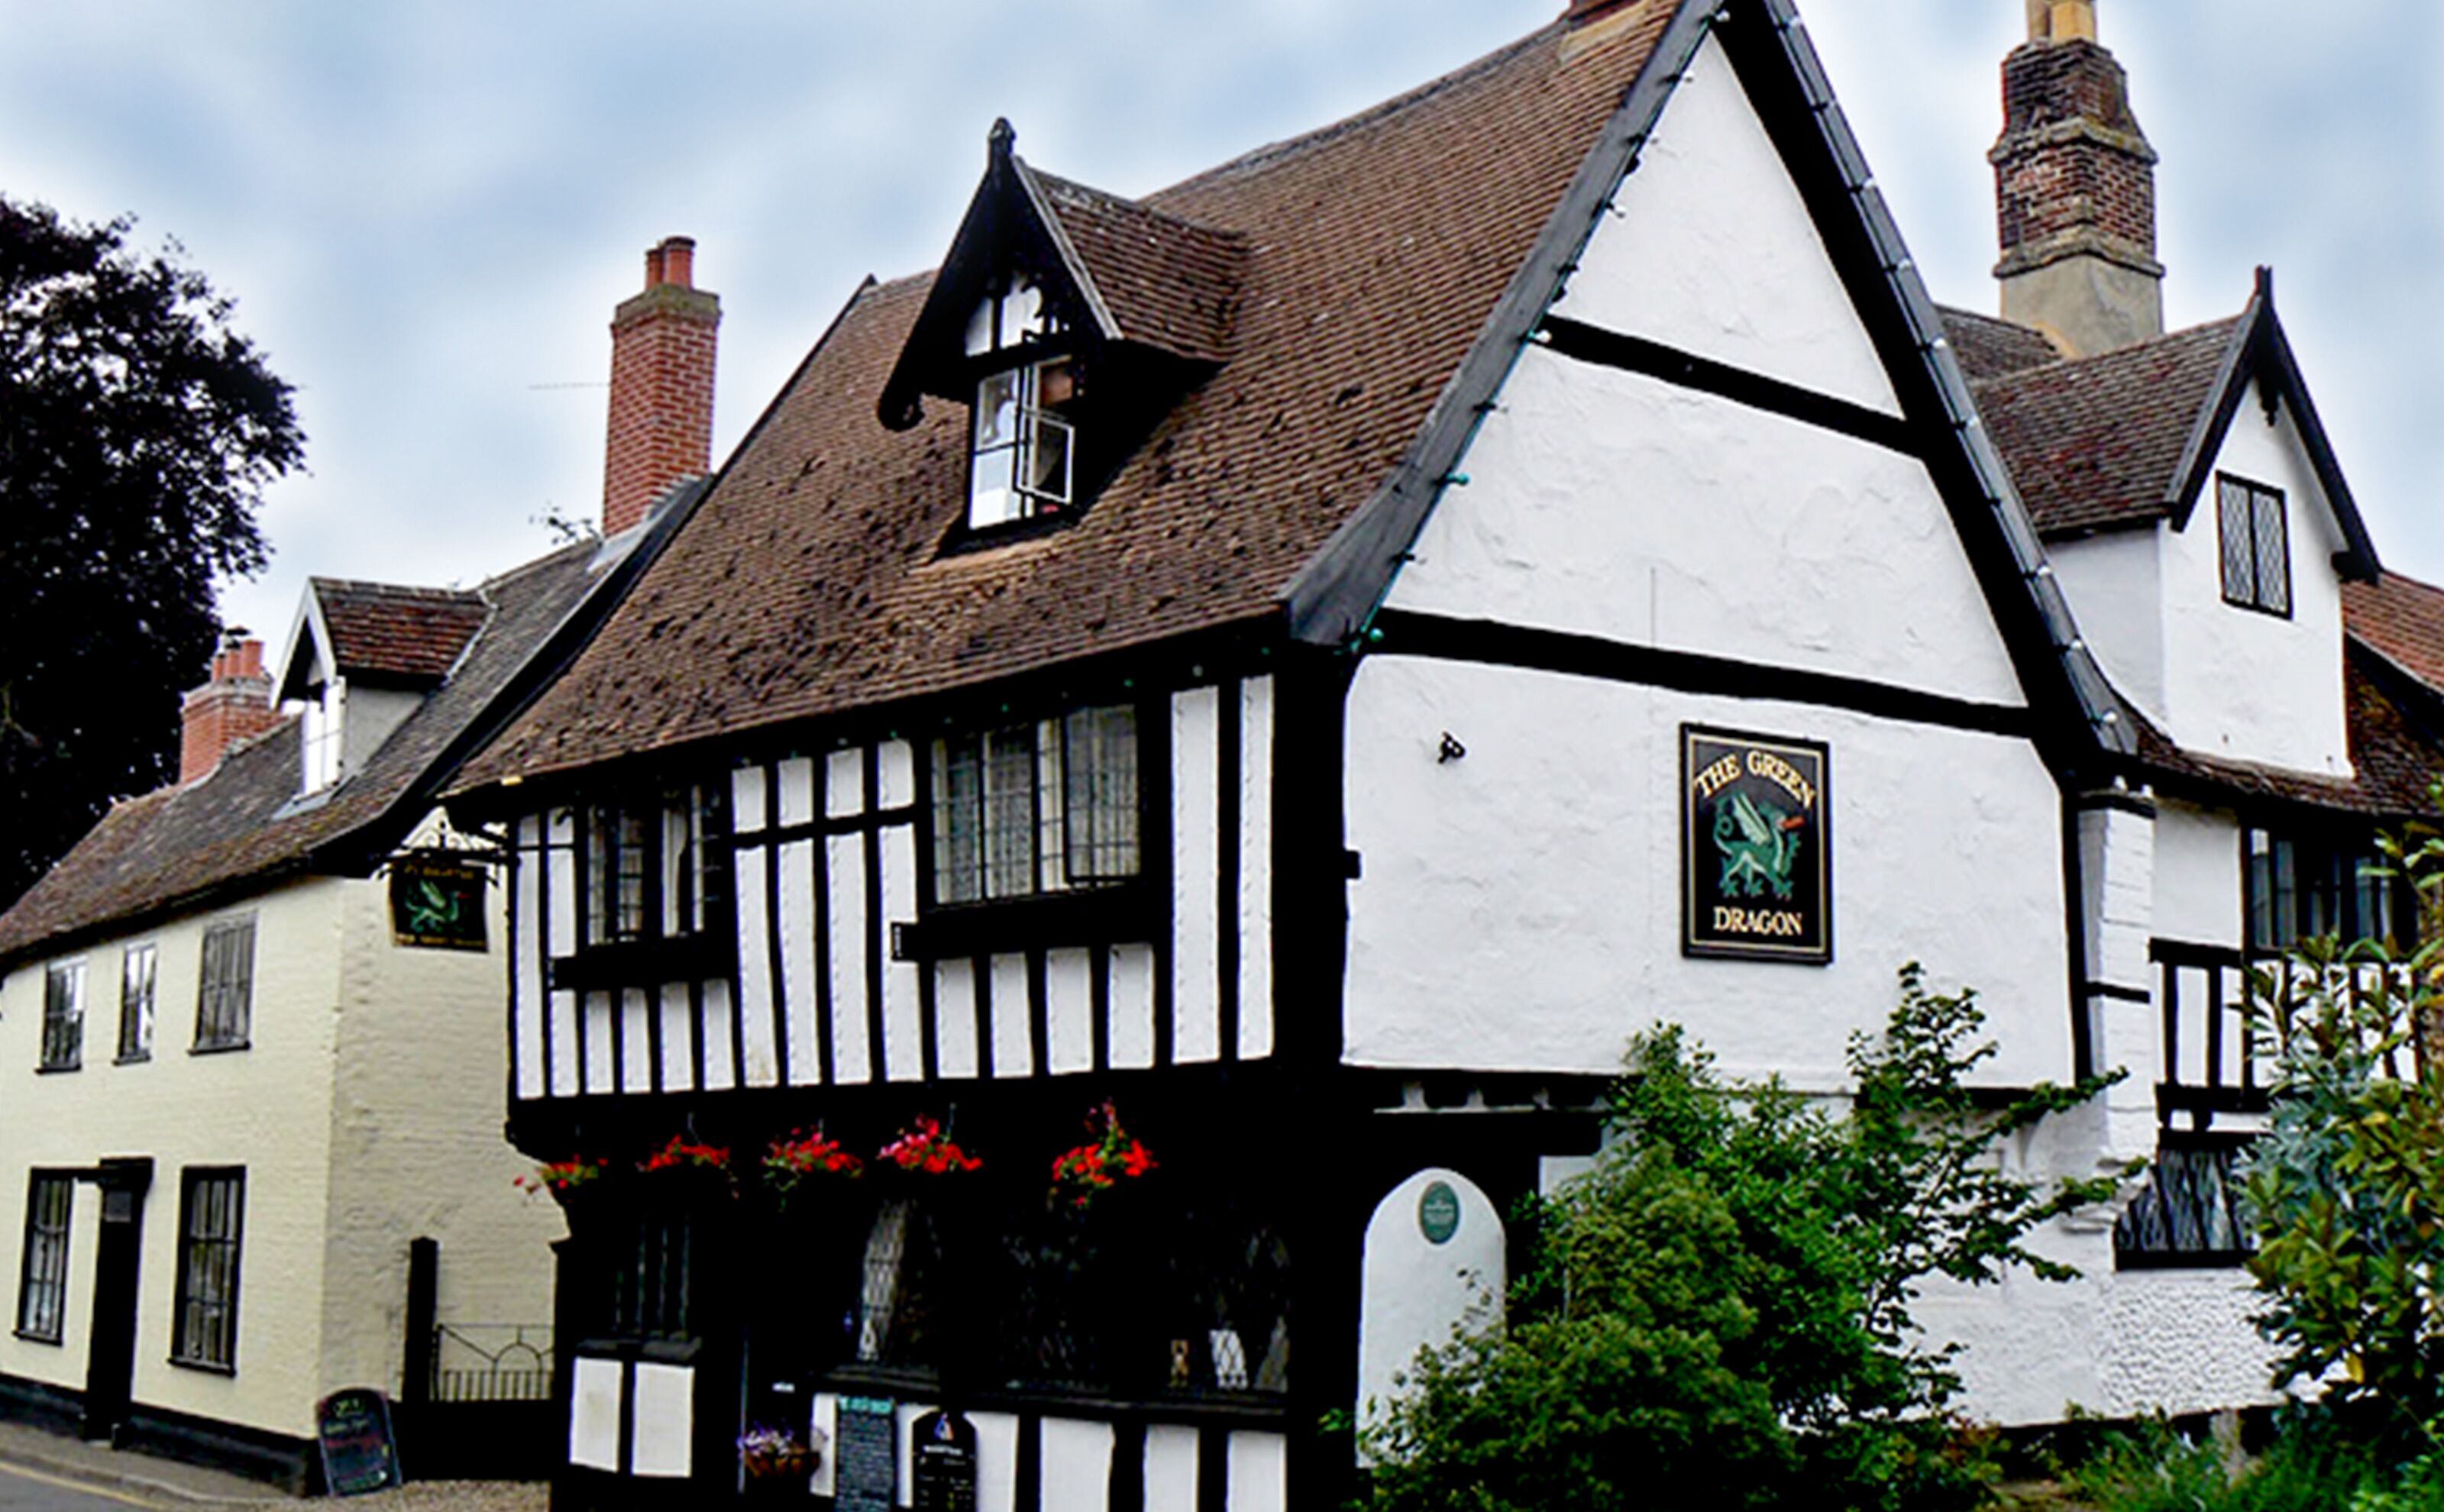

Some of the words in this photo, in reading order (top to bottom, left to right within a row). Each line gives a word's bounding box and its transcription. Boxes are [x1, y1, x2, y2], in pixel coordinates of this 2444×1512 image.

[1693, 754, 1742, 798] THE
[1746, 750, 1815, 809] GREEN
[1713, 906, 1802, 935] DRAGON
